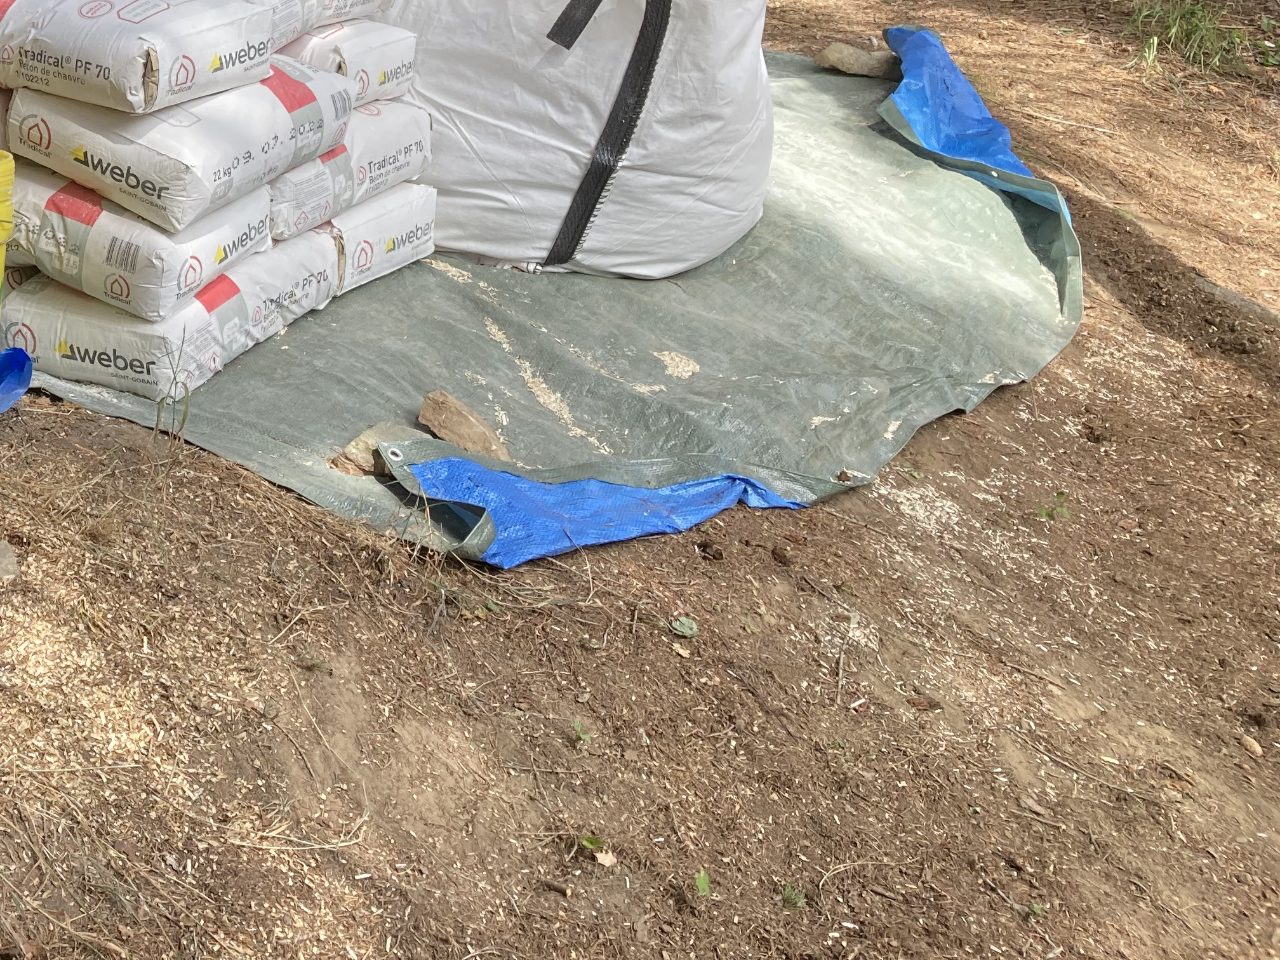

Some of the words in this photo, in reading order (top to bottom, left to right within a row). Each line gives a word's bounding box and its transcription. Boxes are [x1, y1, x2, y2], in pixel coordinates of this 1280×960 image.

[74, 58, 93, 75] PF
[95, 64, 111, 81] 70
[223, 38, 270, 70] weber
[41, 66, 51, 76] de
[403, 143, 413, 158] PF
[414, 139, 425, 154] 70
[90, 151, 170, 200] weber
[213, 169, 221, 182] 22
[222, 166, 232, 178] kg
[227, 214, 269, 257] weber
[395, 218, 435, 250] weber
[76, 345, 156, 376] weber
